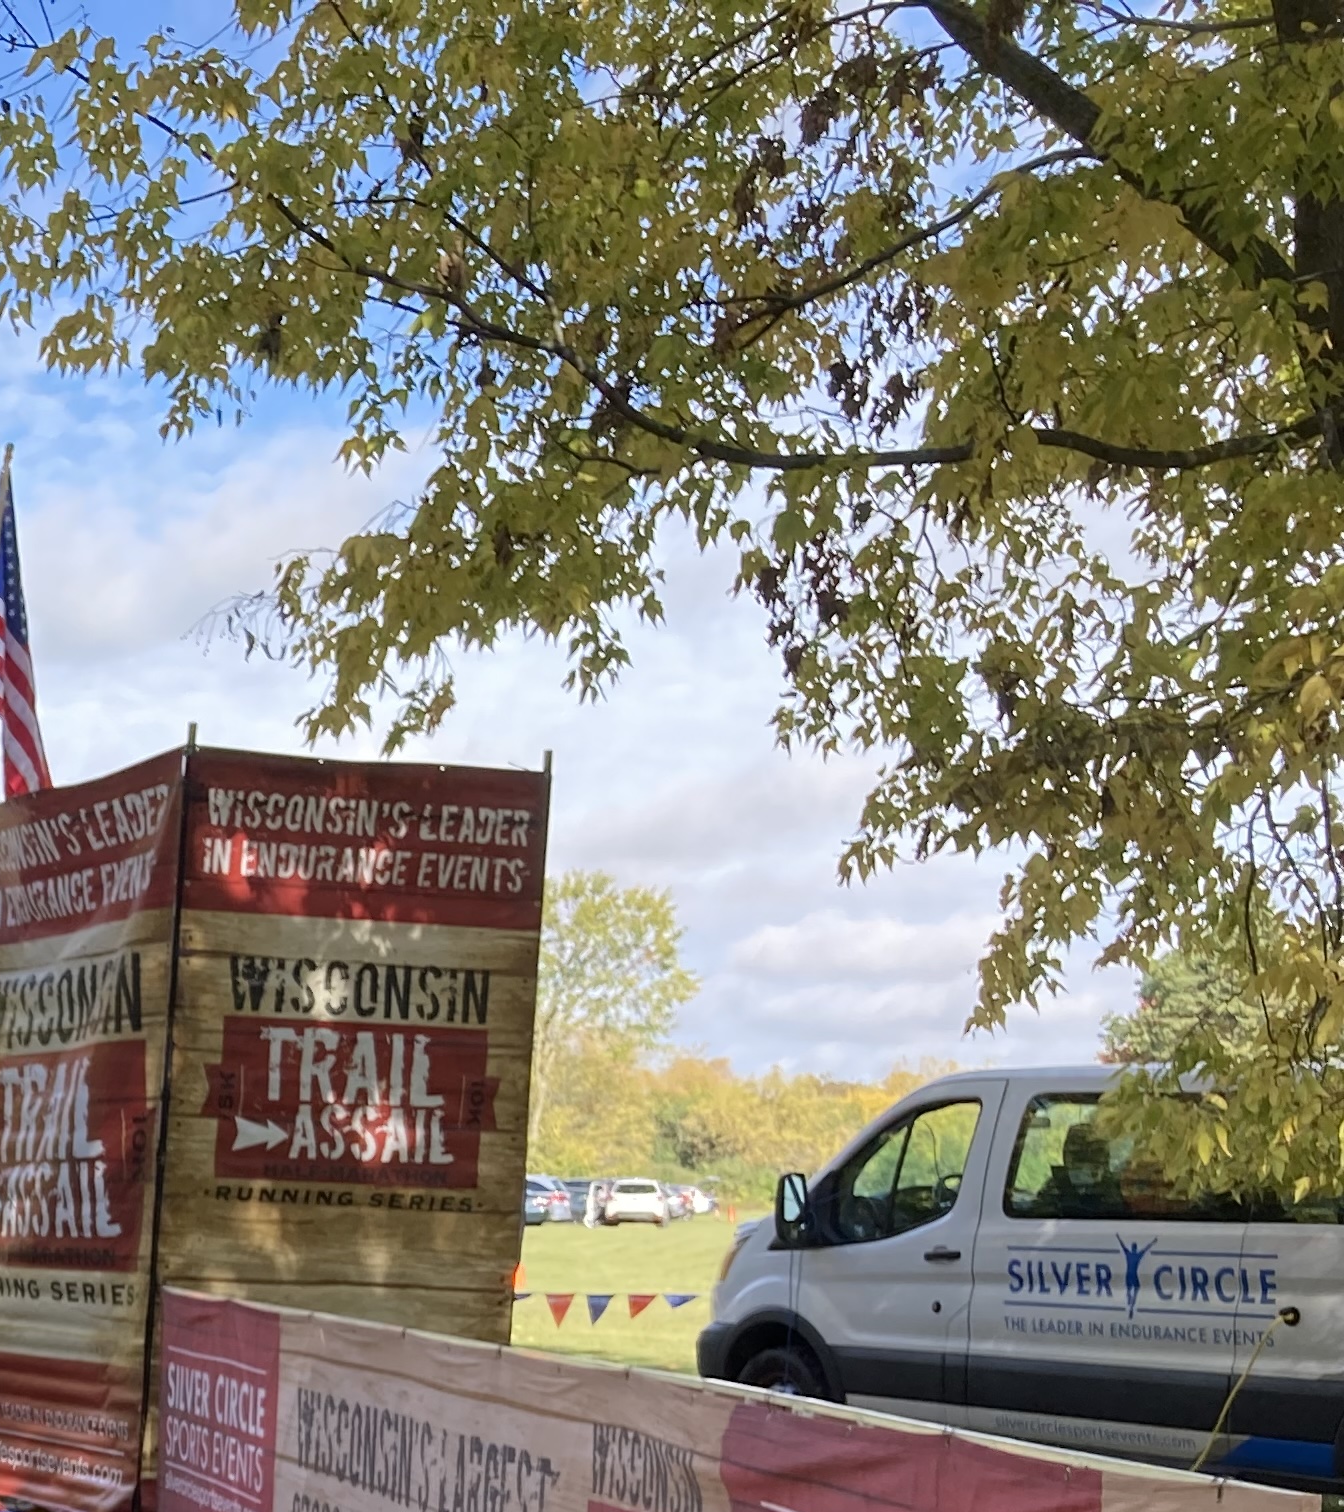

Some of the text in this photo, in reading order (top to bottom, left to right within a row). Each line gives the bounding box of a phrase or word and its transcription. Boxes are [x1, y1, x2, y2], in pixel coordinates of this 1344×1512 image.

[208, 787, 530, 847] WISCONSIN'S LEADER
[203, 837, 524, 893] IN ENDURANCE EVENTS
[7, 868, 96, 927] ENDURANCE
[230, 954, 491, 1025] WISCONSIN
[260, 1025, 445, 1108] TRAIL
[289, 1104, 454, 1165] ASSAIL
[1, 1161, 122, 1238] ASSAIL
[1008, 1259, 1277, 1305] SILVER CIRCLE
[1004, 1316, 1275, 1348] THE LEADER IN ENDURANCE EVENTS
[167, 1361, 266, 1438] SILVER CIRCLE
[166, 1415, 263, 1493] SPORTS EVENTS
